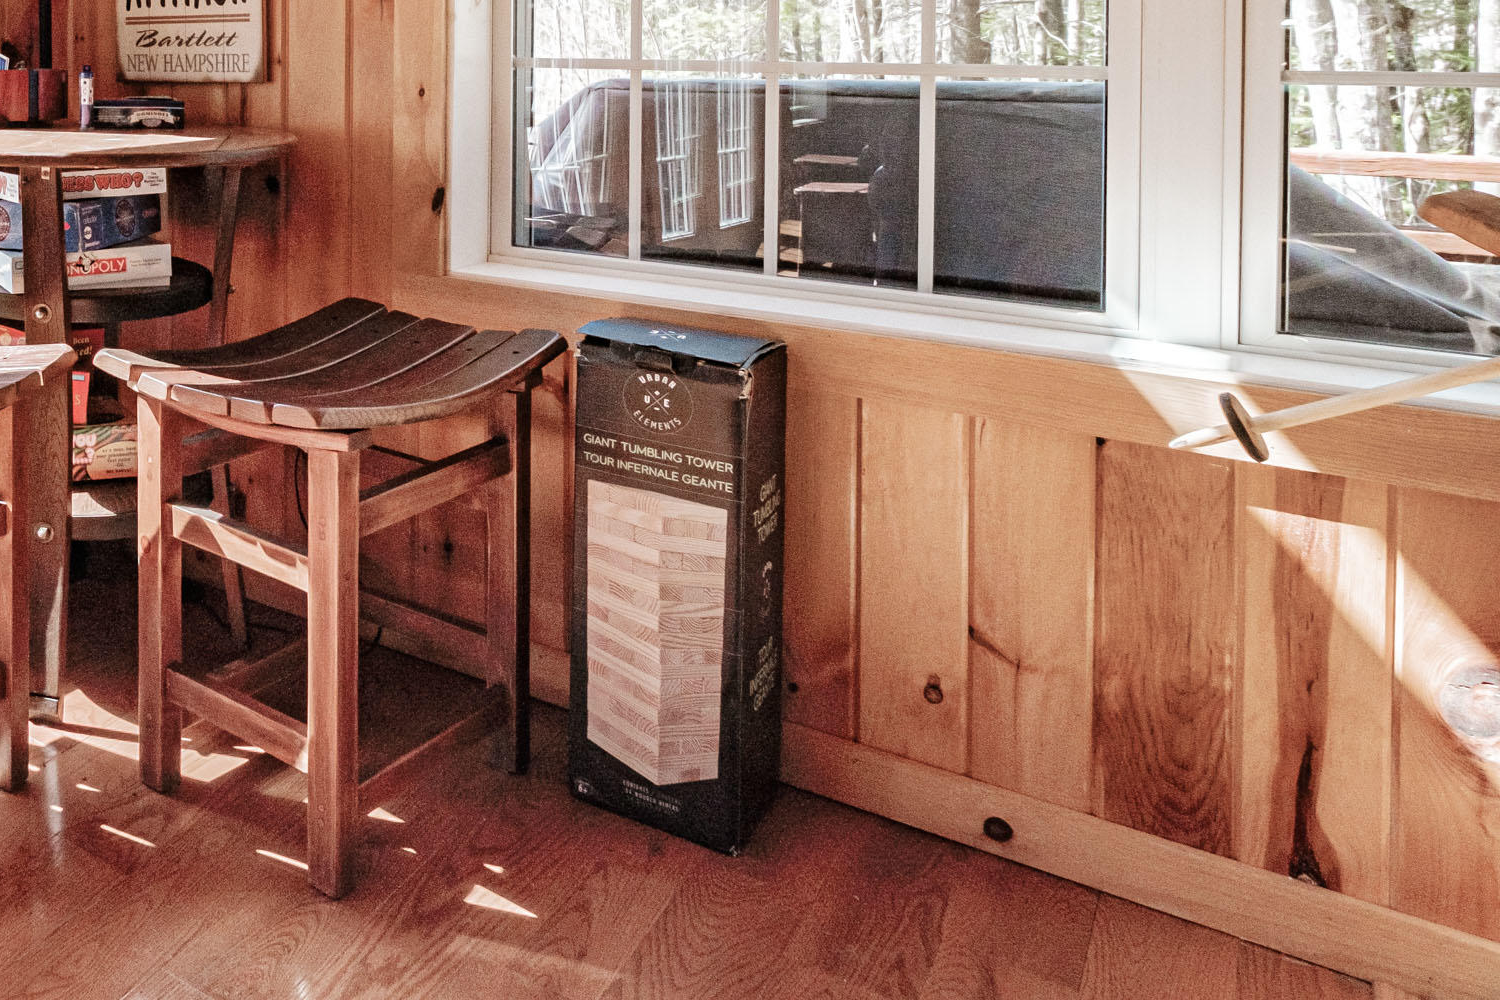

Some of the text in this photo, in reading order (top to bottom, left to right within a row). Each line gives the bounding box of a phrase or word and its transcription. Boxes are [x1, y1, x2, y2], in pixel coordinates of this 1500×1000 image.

[135, 28, 239, 49] Bartlett
[126, 52, 250, 73] NEW HAMPSHIRE
[95, 172, 144, 190] WHO?
[638, 373, 676, 389] URBAN
[633, 410, 682, 430] ELEMENTS
[583, 433, 734, 473] GIANT TUMBLING TOWER
[583, 451, 734, 494] TOUR INFERNALE GEANTE
